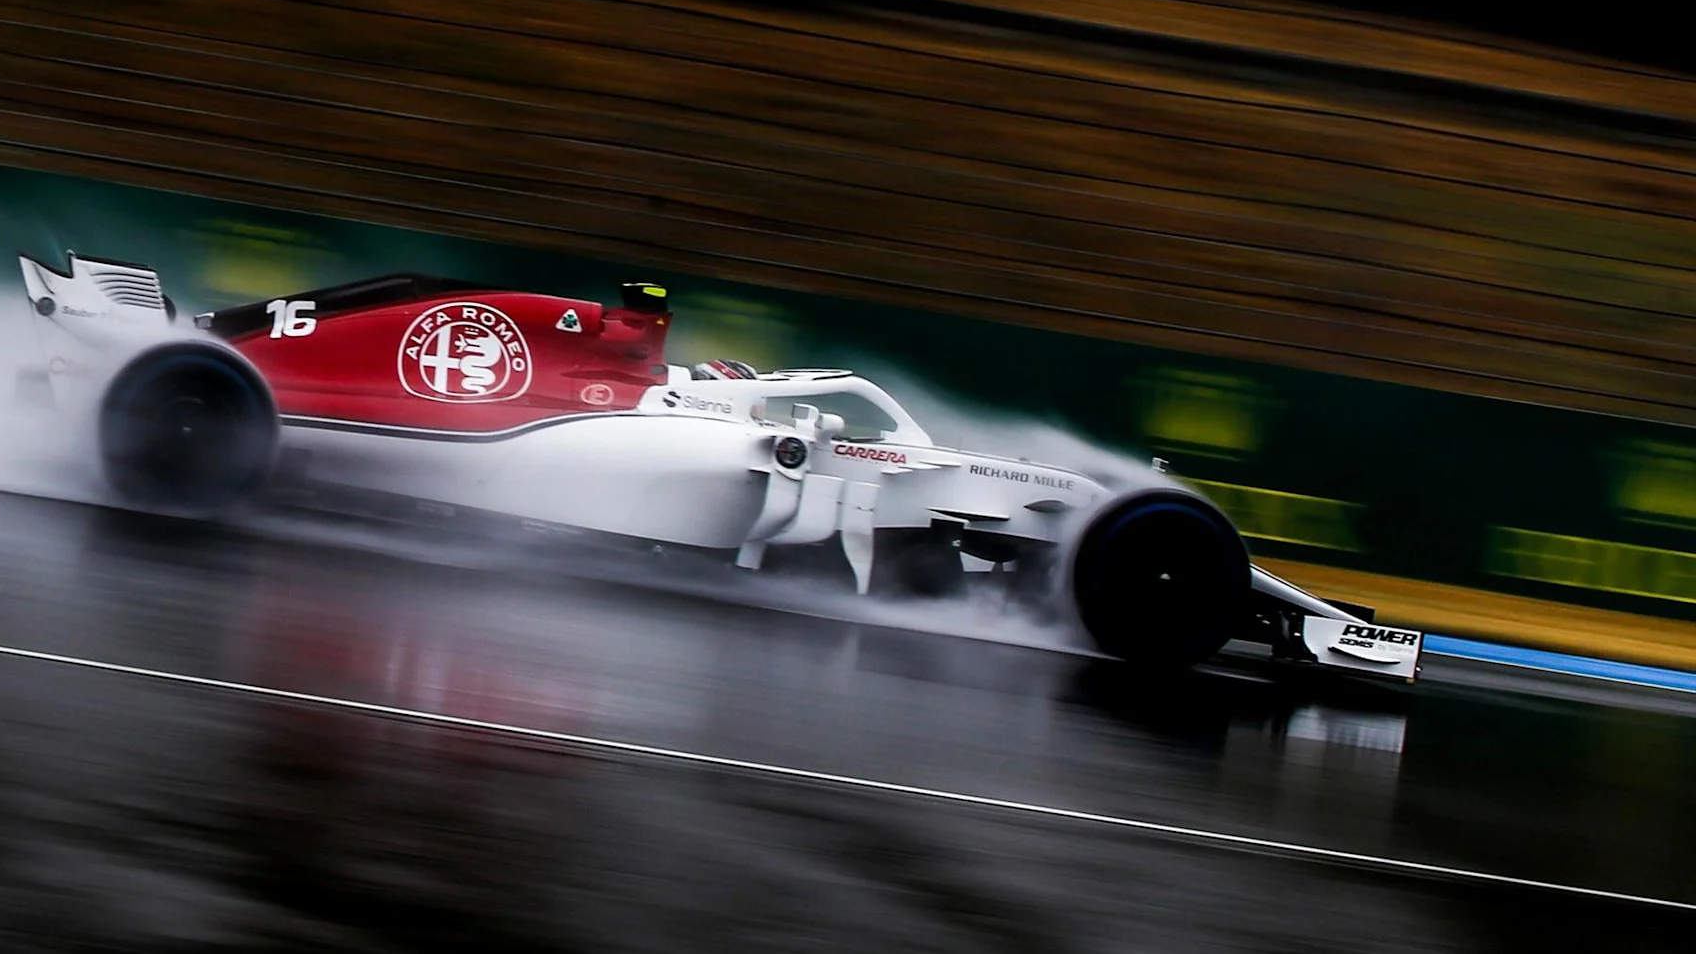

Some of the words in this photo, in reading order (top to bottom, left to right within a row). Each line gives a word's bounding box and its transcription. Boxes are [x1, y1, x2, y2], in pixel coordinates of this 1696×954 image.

[266, 299, 317, 339] 16
[405, 311, 452, 360] ALFA
[462, 307, 525, 372] ROMEO
[834, 444, 907, 464] CARRERA
[969, 465, 1029, 483] RICHARD
[1033, 475, 1075, 490] MILLE
[1342, 624, 1417, 645] POWER
